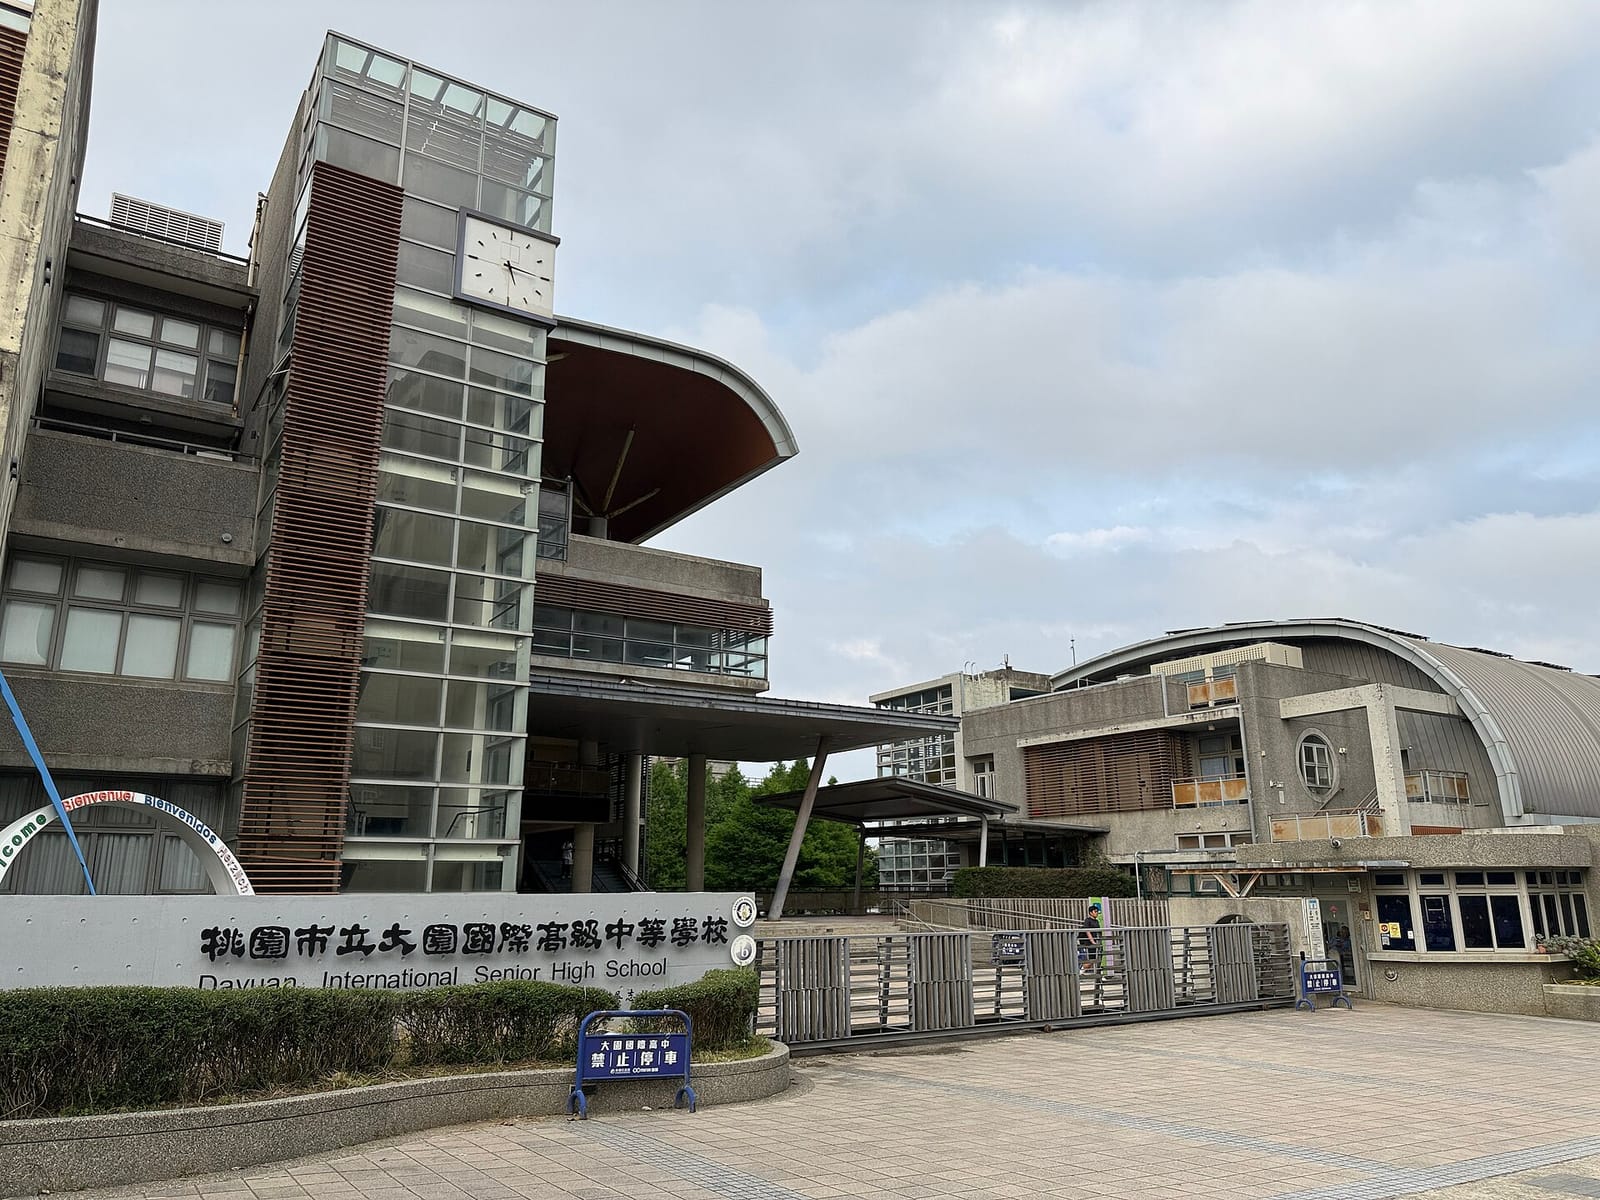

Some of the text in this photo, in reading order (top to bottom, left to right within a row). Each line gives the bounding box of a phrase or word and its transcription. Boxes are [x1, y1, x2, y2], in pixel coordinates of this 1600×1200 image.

[145, 795, 216, 844] Bienvenidos
[323, 967, 457, 988] International
[475, 966, 540, 983] Senior
[552, 961, 594, 983] High
[606, 958, 666, 977] School
[591, 1051, 677, 1067] 禁止停車
